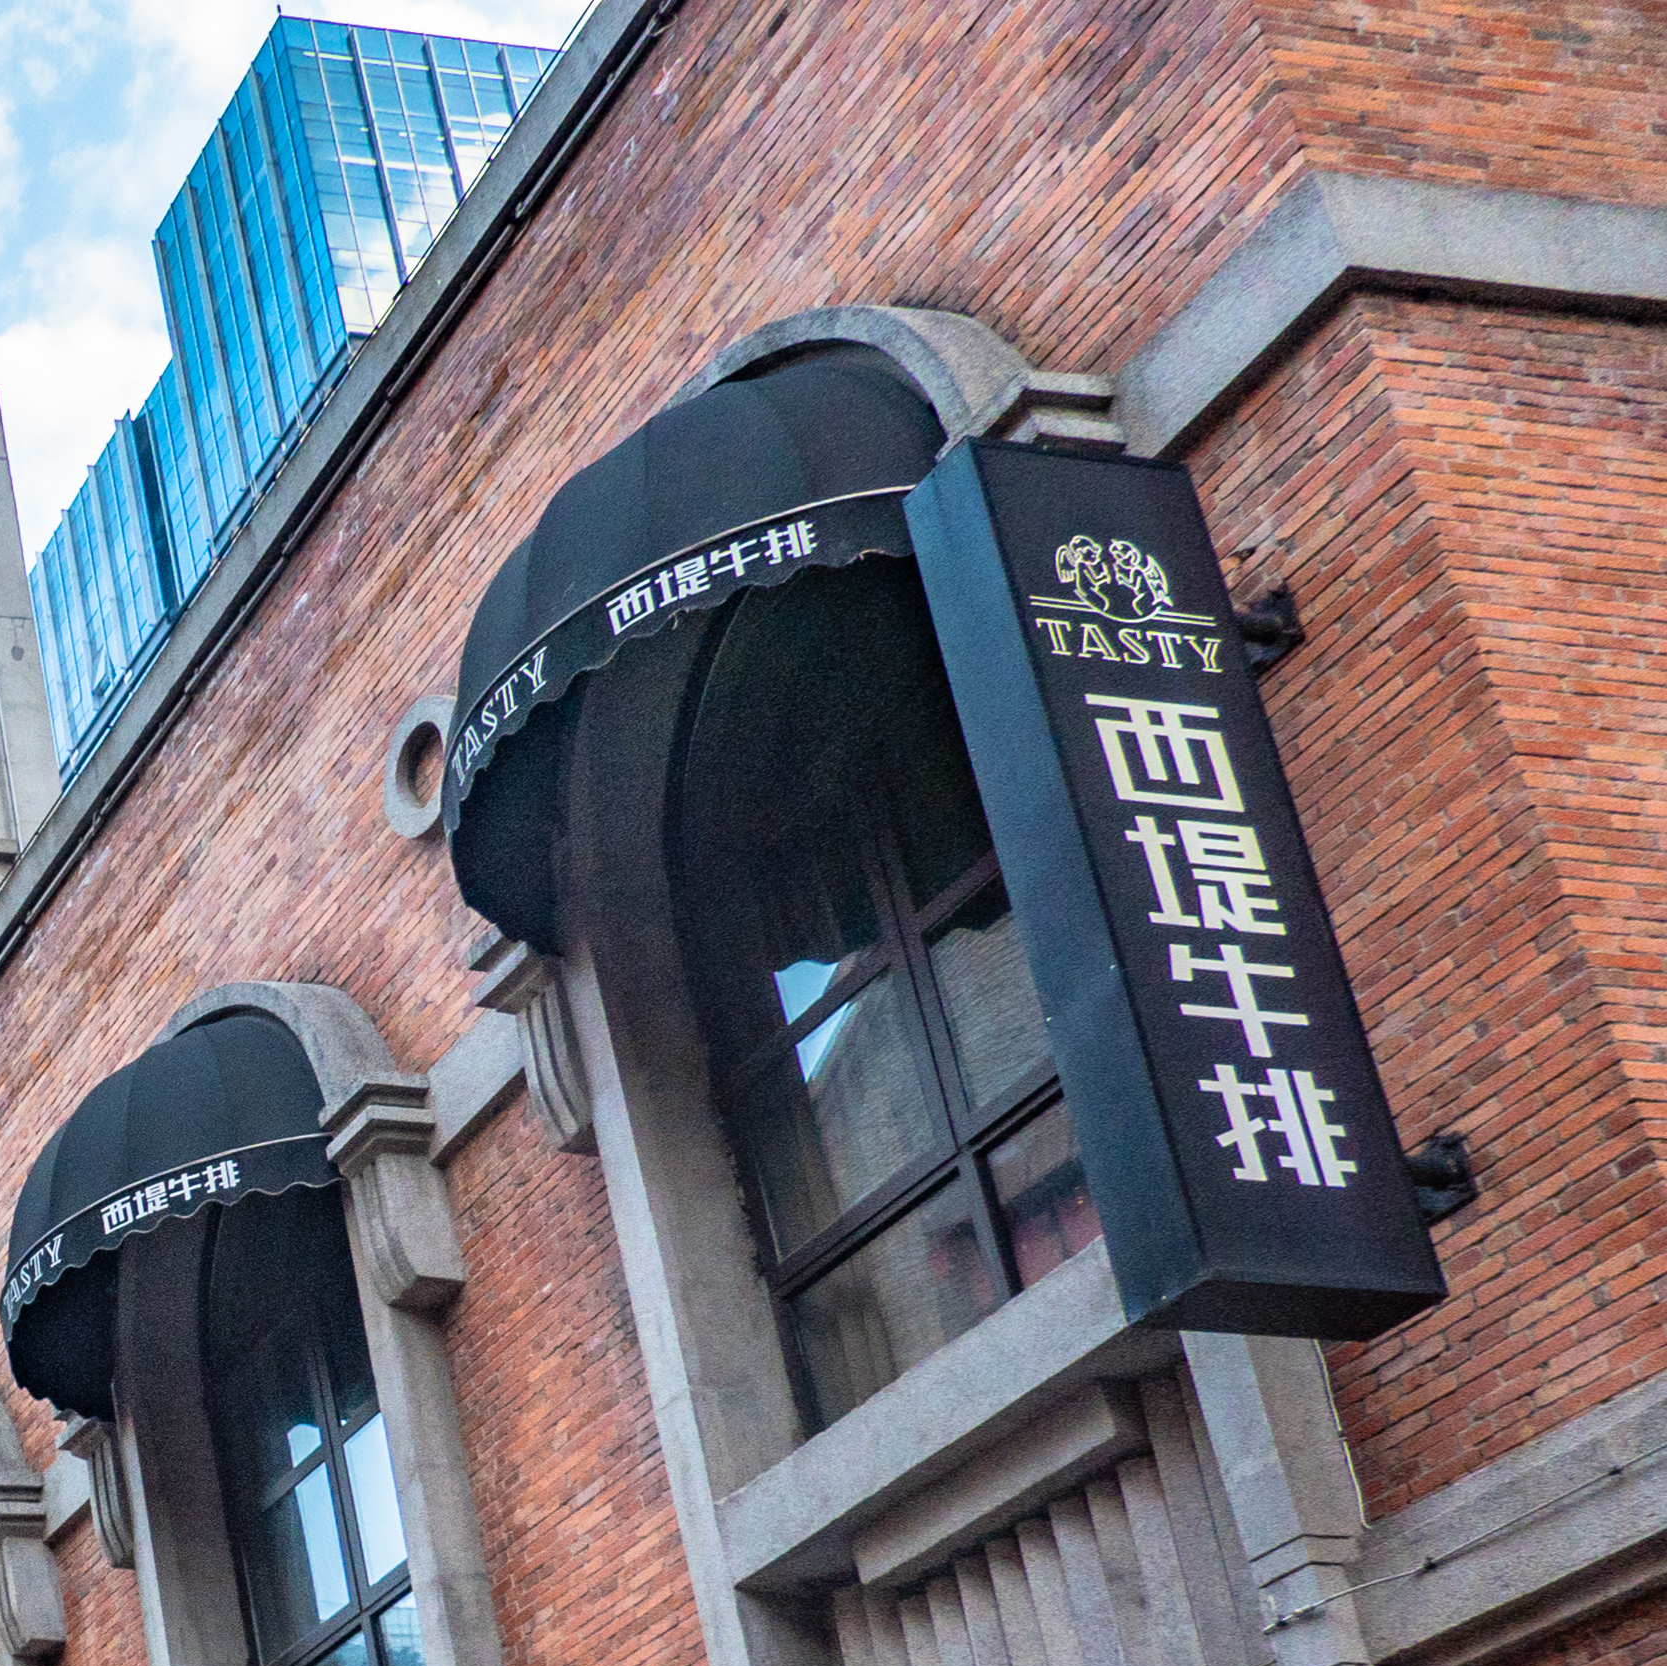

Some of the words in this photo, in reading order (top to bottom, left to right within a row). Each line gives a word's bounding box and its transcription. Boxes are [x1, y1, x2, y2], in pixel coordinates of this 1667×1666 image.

[605, 519, 817, 635] 西堤牛排
[1035, 616, 1224, 674] TASTY
[451, 647, 549, 786] TASTY
[1084, 693, 1358, 1188] 西堤牛排
[101, 1159, 241, 1234] 西堤牛排
